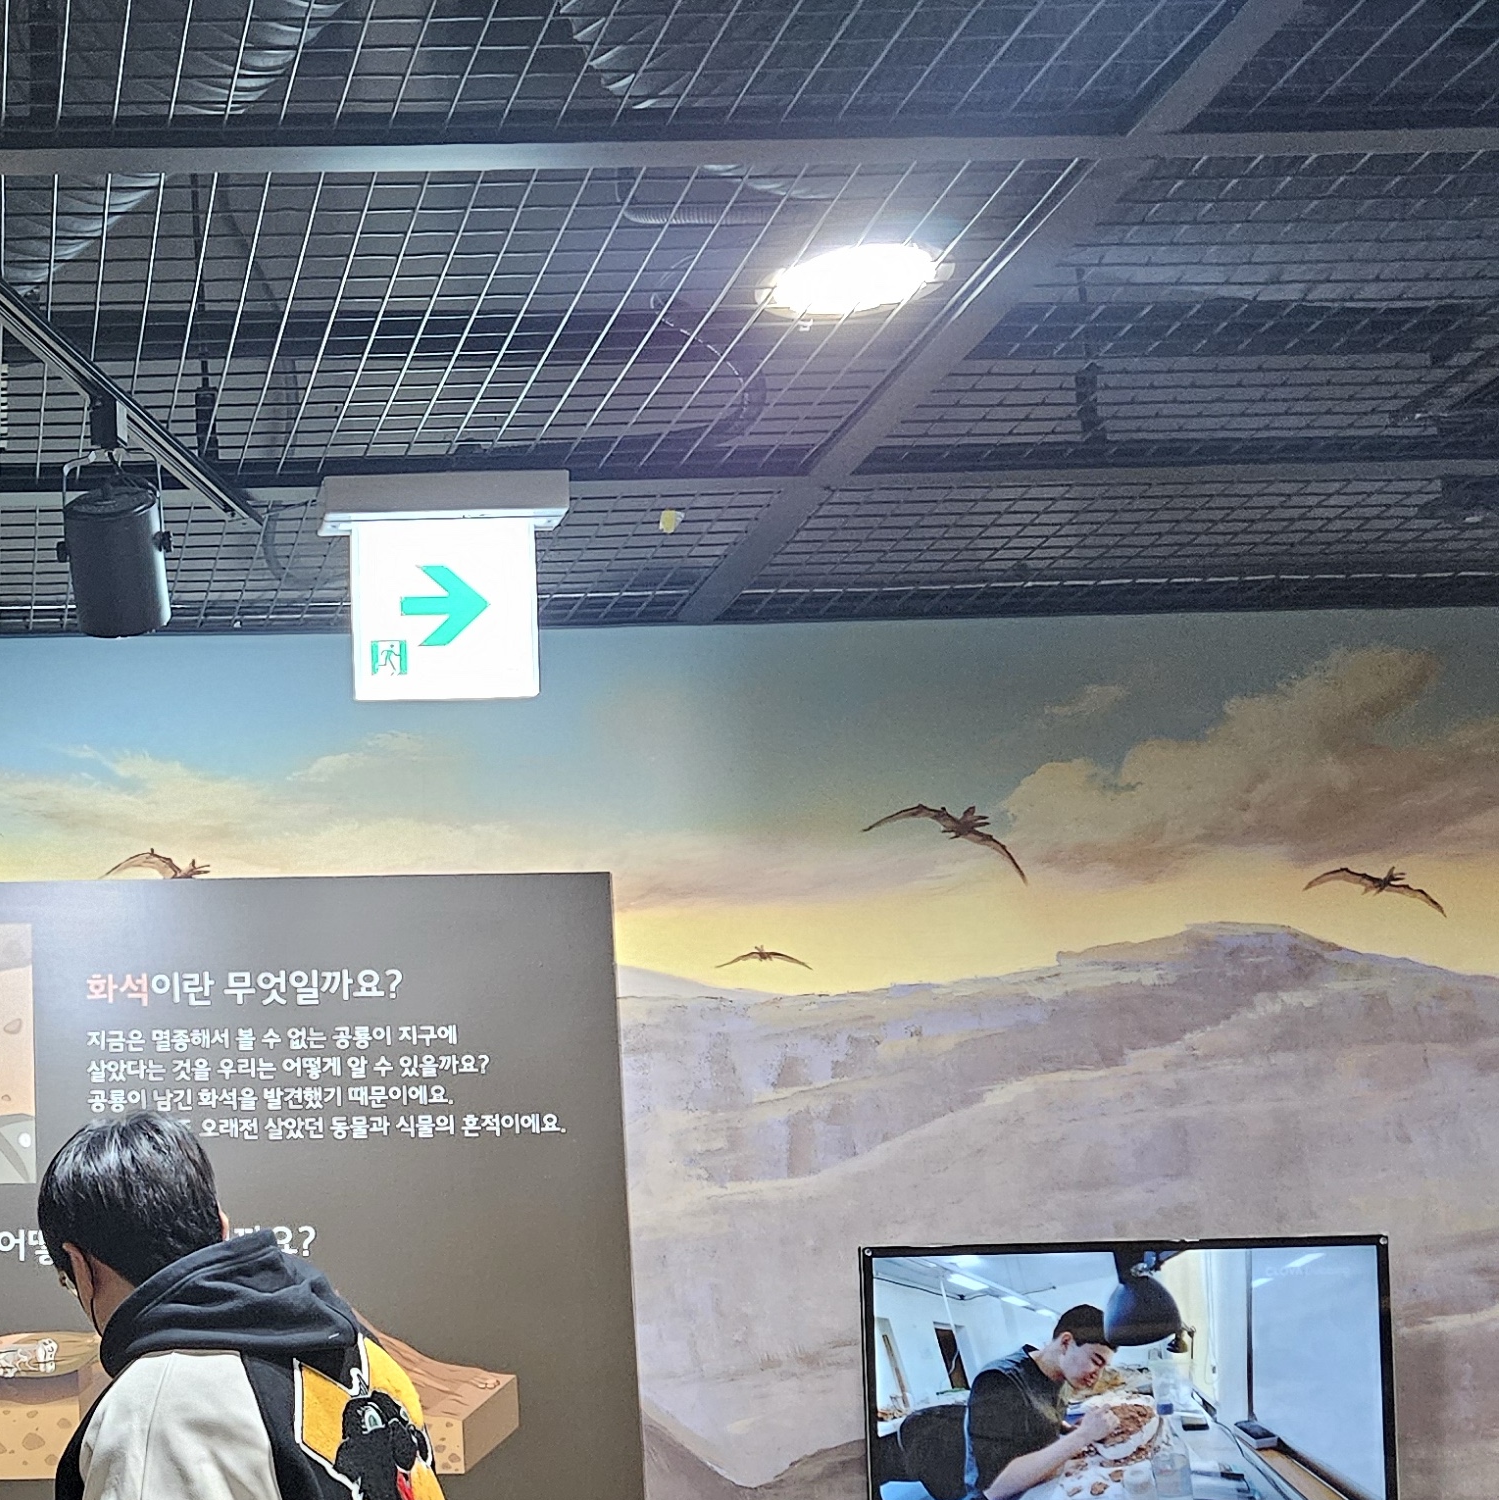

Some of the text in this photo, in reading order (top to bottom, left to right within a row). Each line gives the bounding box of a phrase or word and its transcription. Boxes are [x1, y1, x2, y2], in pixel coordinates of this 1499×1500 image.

[86, 969, 403, 1006] 화석이란 무엇일까요?
[86, 1024, 458, 1052] 지금은 멸종해서 볼 수 없는 공룡이 지구에
[86, 1054, 490, 1083] 살았다는 것을 우리는 어떻게 알 수 있을까요?
[87, 1084, 454, 1112] 공룡이 남긴 화석을 발견했기 때문이에요.
[199, 1118, 259, 1140] 오래전
[265, 1117, 324, 1140] 살았던
[330, 1116, 390, 1139] 동물과
[396, 1115, 455, 1138] 식물의
[461, 1113, 567, 1137] 흔적이에요.
